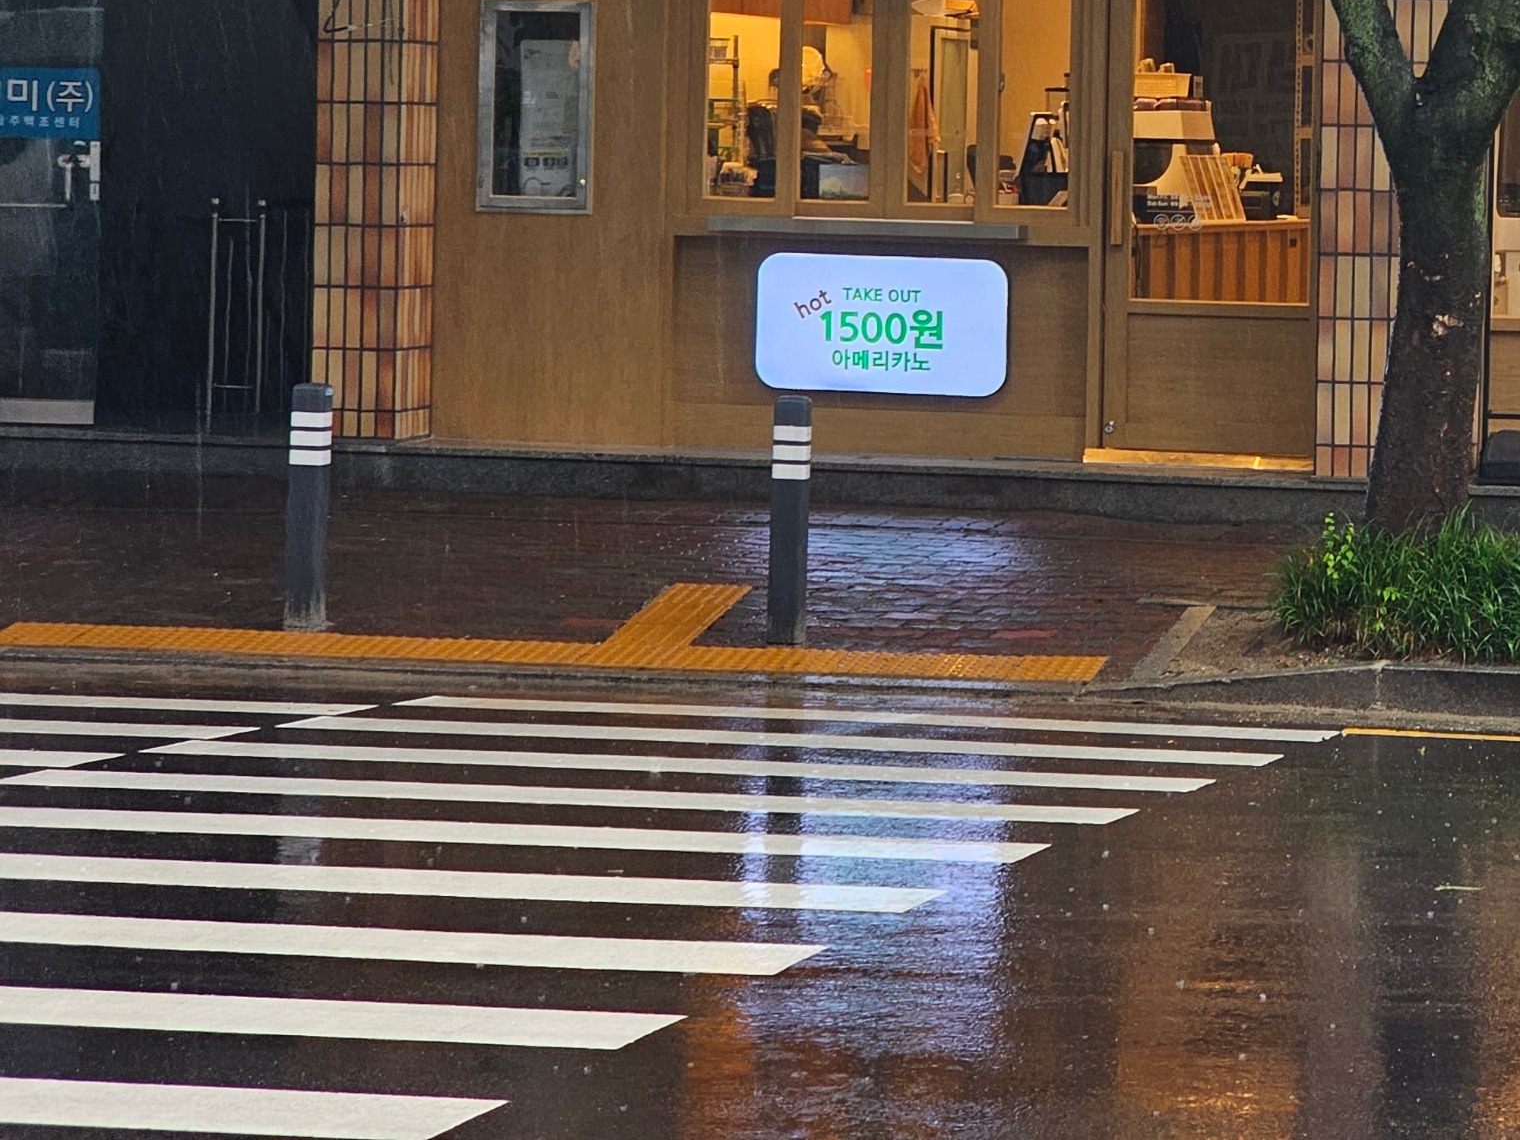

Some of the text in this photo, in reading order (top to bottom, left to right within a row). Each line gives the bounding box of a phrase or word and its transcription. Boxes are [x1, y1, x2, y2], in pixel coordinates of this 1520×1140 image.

[0, 79, 94, 113] 미(주)
[794, 289, 832, 319] hot
[842, 287, 922, 303] TAKE OUT
[819, 309, 944, 350] 1500원
[831, 349, 931, 373] 아메리카노
